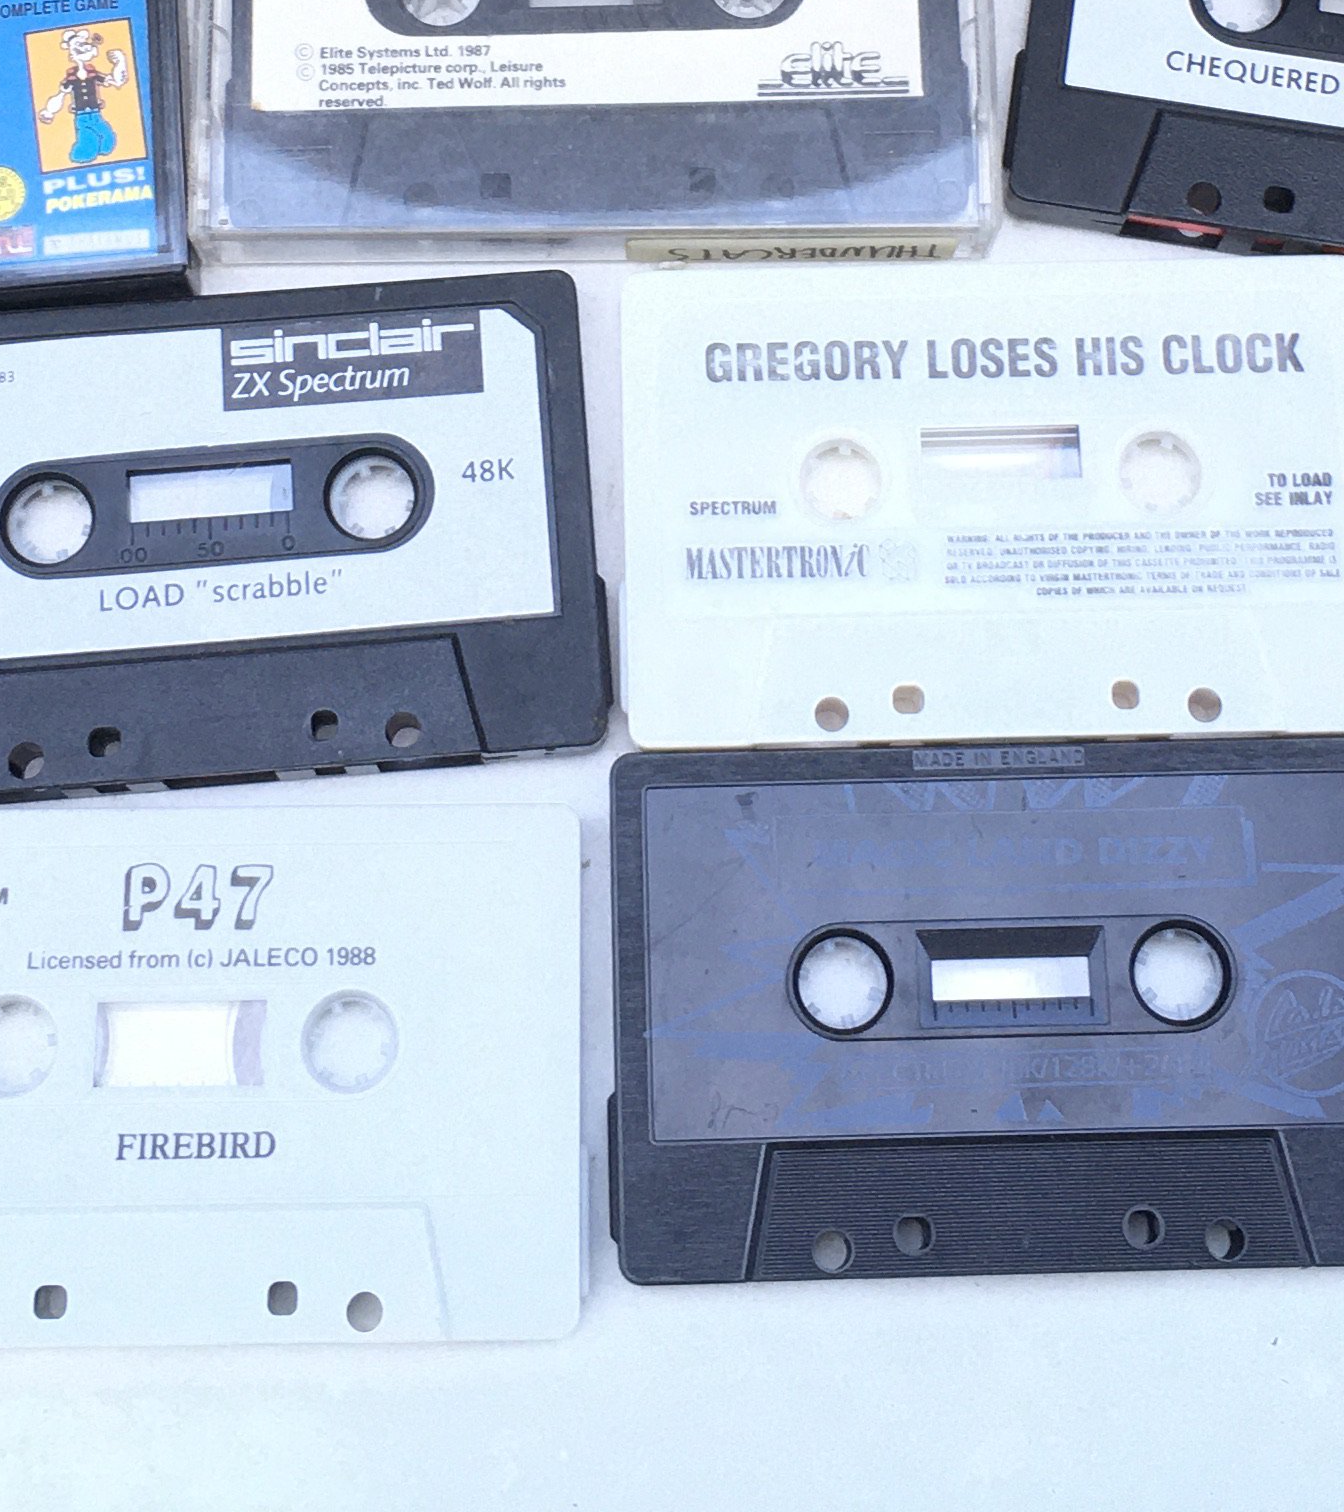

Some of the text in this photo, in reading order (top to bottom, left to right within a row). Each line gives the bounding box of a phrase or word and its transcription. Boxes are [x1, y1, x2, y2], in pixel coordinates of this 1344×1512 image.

[319, 45, 490, 62] Elite Systems Ltd. 1987
[1165, 51, 1339, 95] CHEQUERED
[230, 320, 474, 366] sinclair
[705, 333, 1305, 382] GREGORY LOSES HIS CLOCK
[232, 365, 410, 399] ZX Spectrum
[461, 459, 514, 483] 48K
[690, 500, 776, 515] SPECTRUM
[99, 583, 185, 612] LOAD
[914, 748, 1084, 768] MADE IN ENGLAND
[122, 862, 275, 932] P47
[27, 945, 375, 971] Licensed from (c) JALECO 1988
[115, 1131, 277, 1161] FIREBIRD
